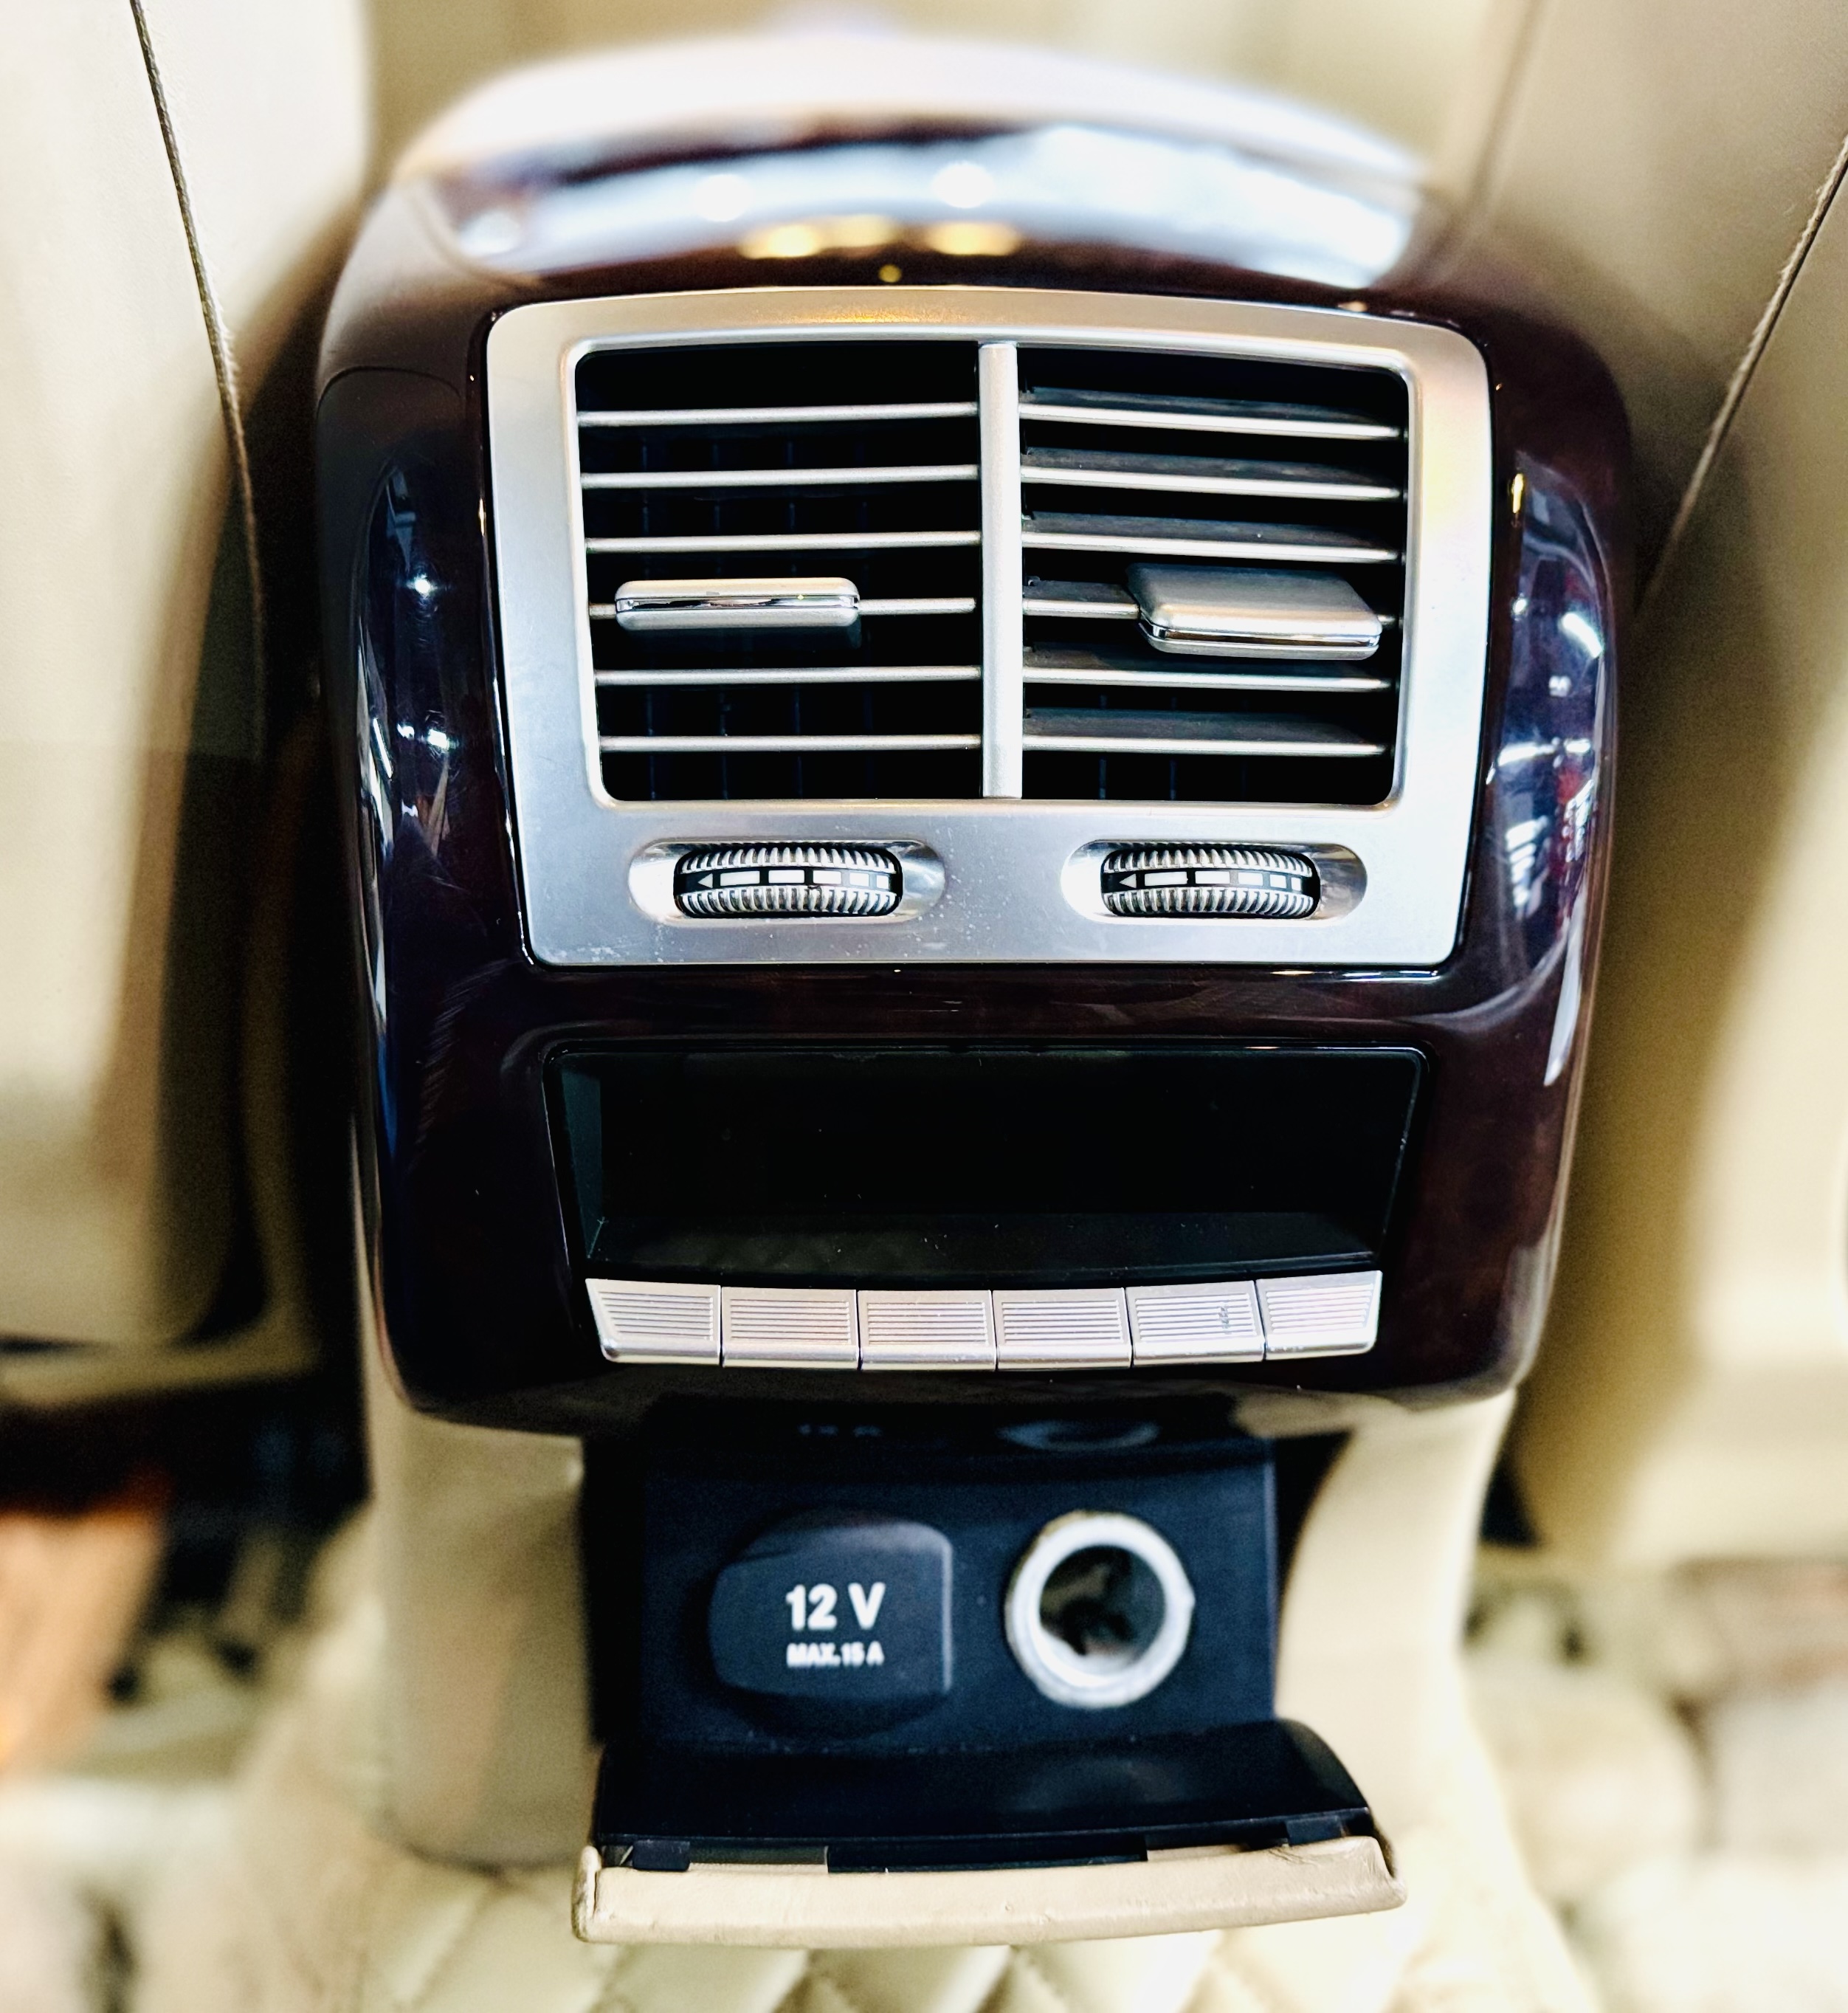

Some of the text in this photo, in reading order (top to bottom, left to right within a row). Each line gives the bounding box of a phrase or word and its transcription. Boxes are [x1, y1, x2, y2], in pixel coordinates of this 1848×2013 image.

[785, 1581, 886, 1631] 12 V
[866, 1640, 885, 1666] A
